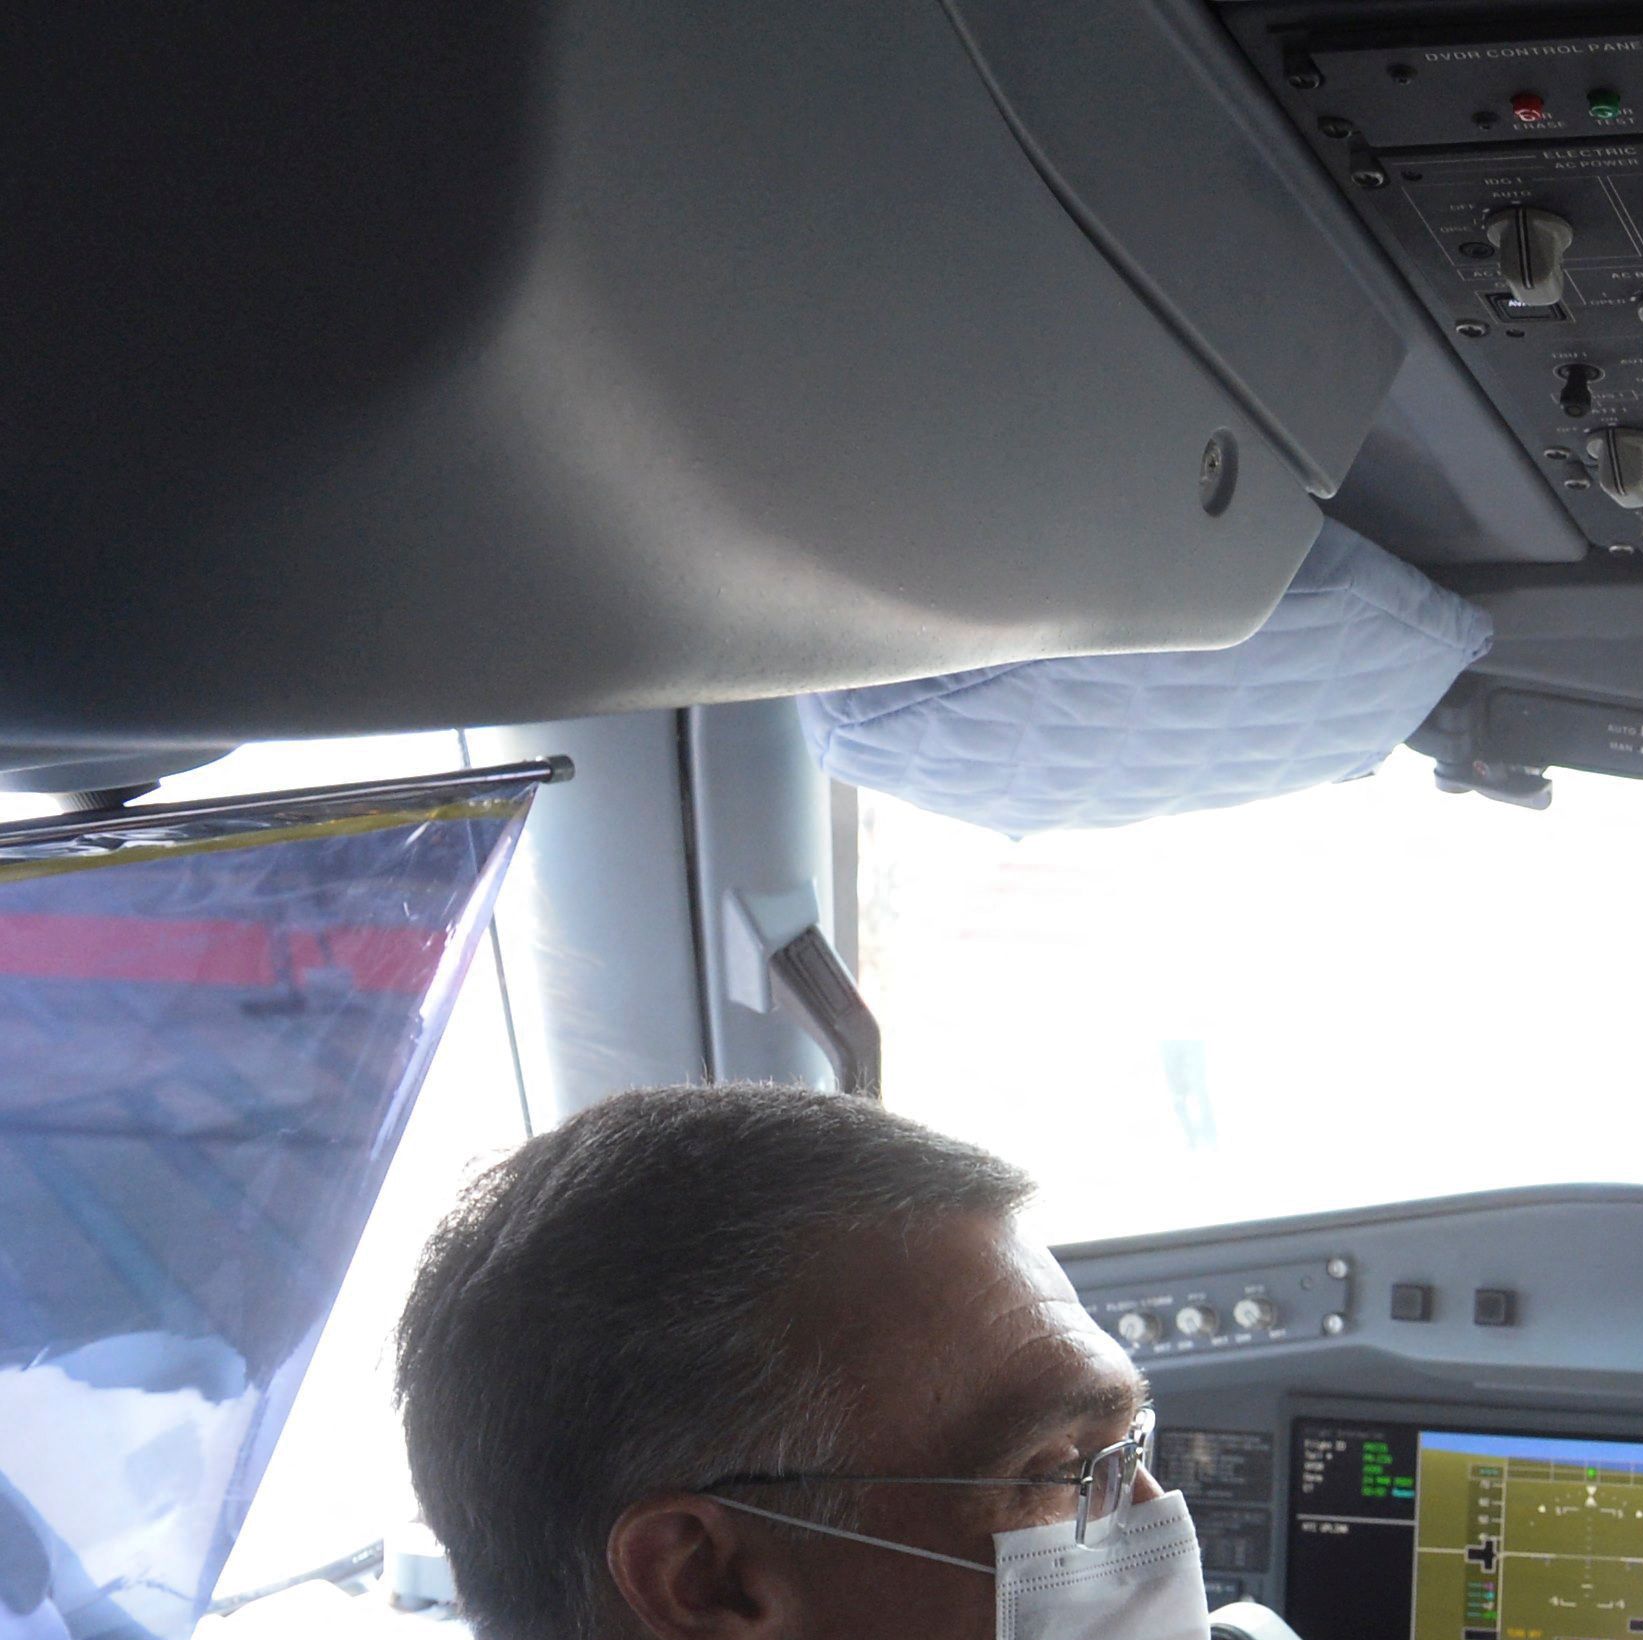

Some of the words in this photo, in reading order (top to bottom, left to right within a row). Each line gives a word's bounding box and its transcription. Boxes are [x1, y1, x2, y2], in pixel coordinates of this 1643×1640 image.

[1486, 44, 1585, 59] CONTROL
[1543, 146, 1637, 159] ELECTRIC
[1555, 160, 1576, 168] AC
[1579, 157, 1641, 168] POWER
